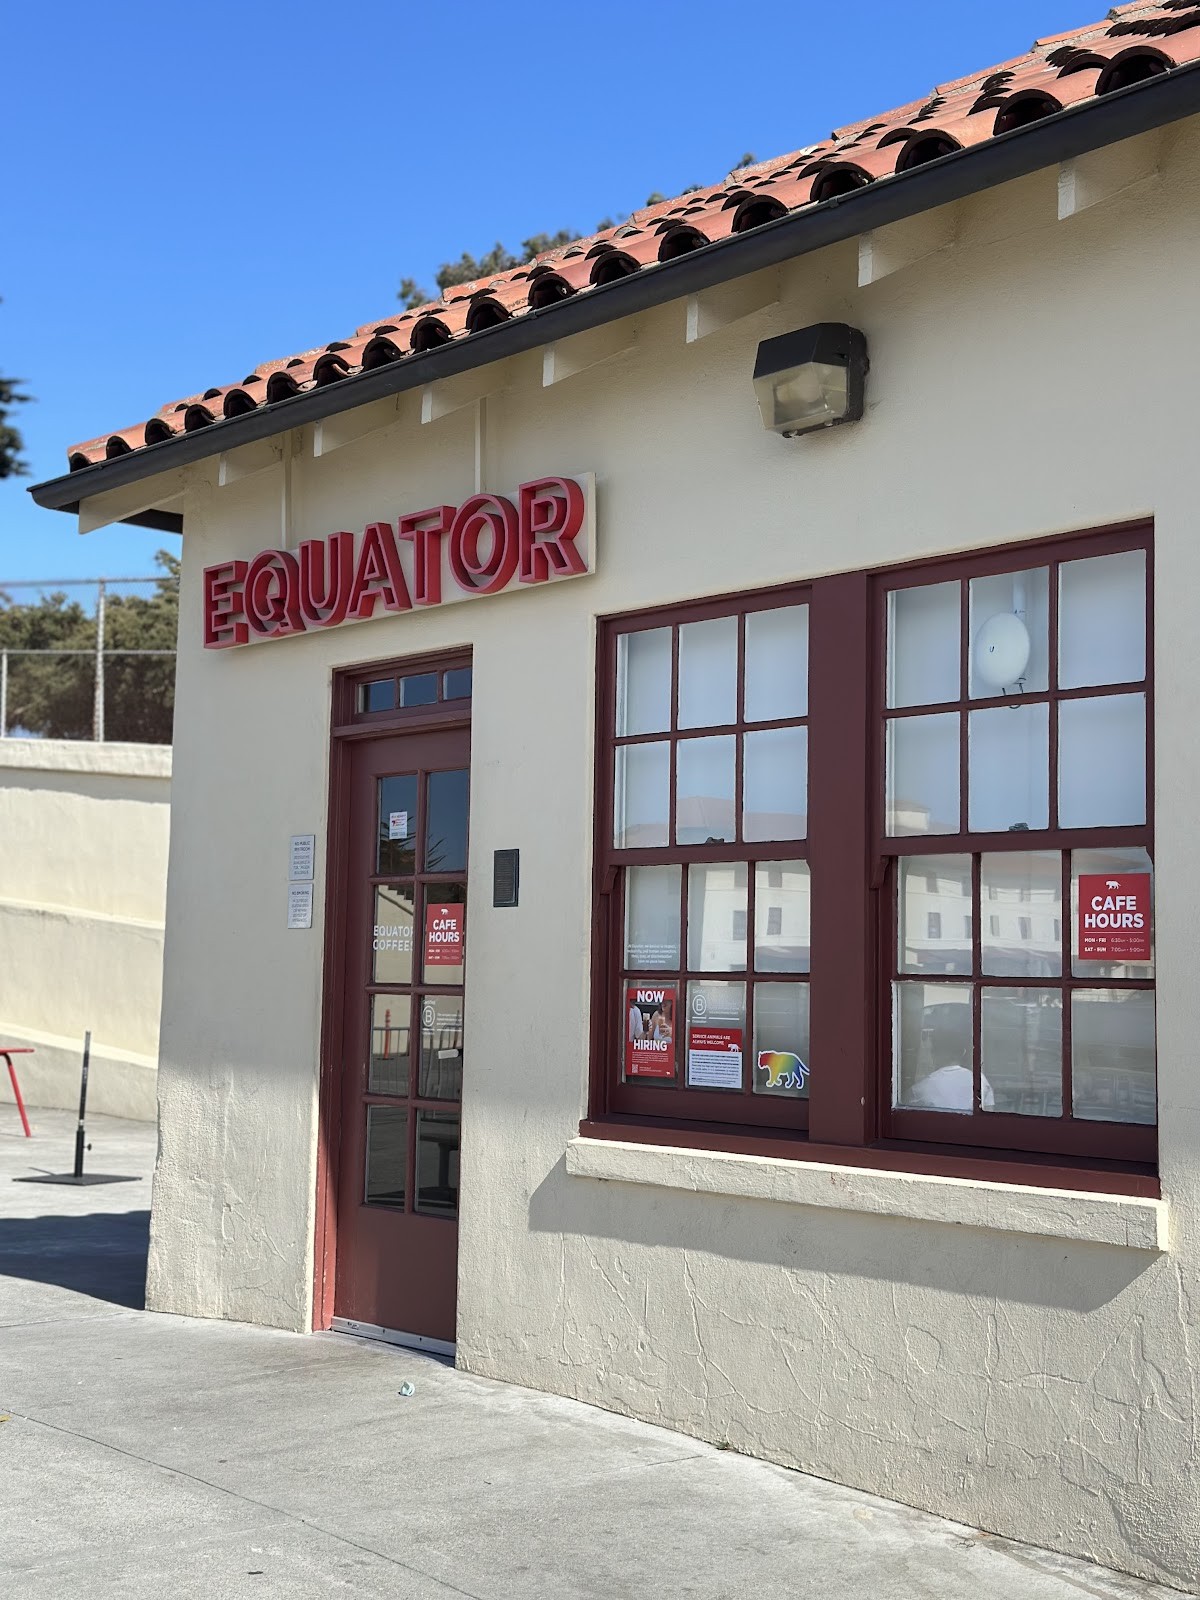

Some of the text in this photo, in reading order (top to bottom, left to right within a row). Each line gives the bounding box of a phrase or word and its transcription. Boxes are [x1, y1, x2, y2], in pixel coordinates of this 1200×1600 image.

[203, 476, 589, 649] EQUATOR
[1091, 895, 1137, 911] CAFE
[433, 919, 457, 930] CAFE
[1084, 912, 1144, 929] HOURS
[429, 932, 460, 943] HOURS
[636, 990, 665, 1003] NOW
[633, 1039, 668, 1052] HIRING
